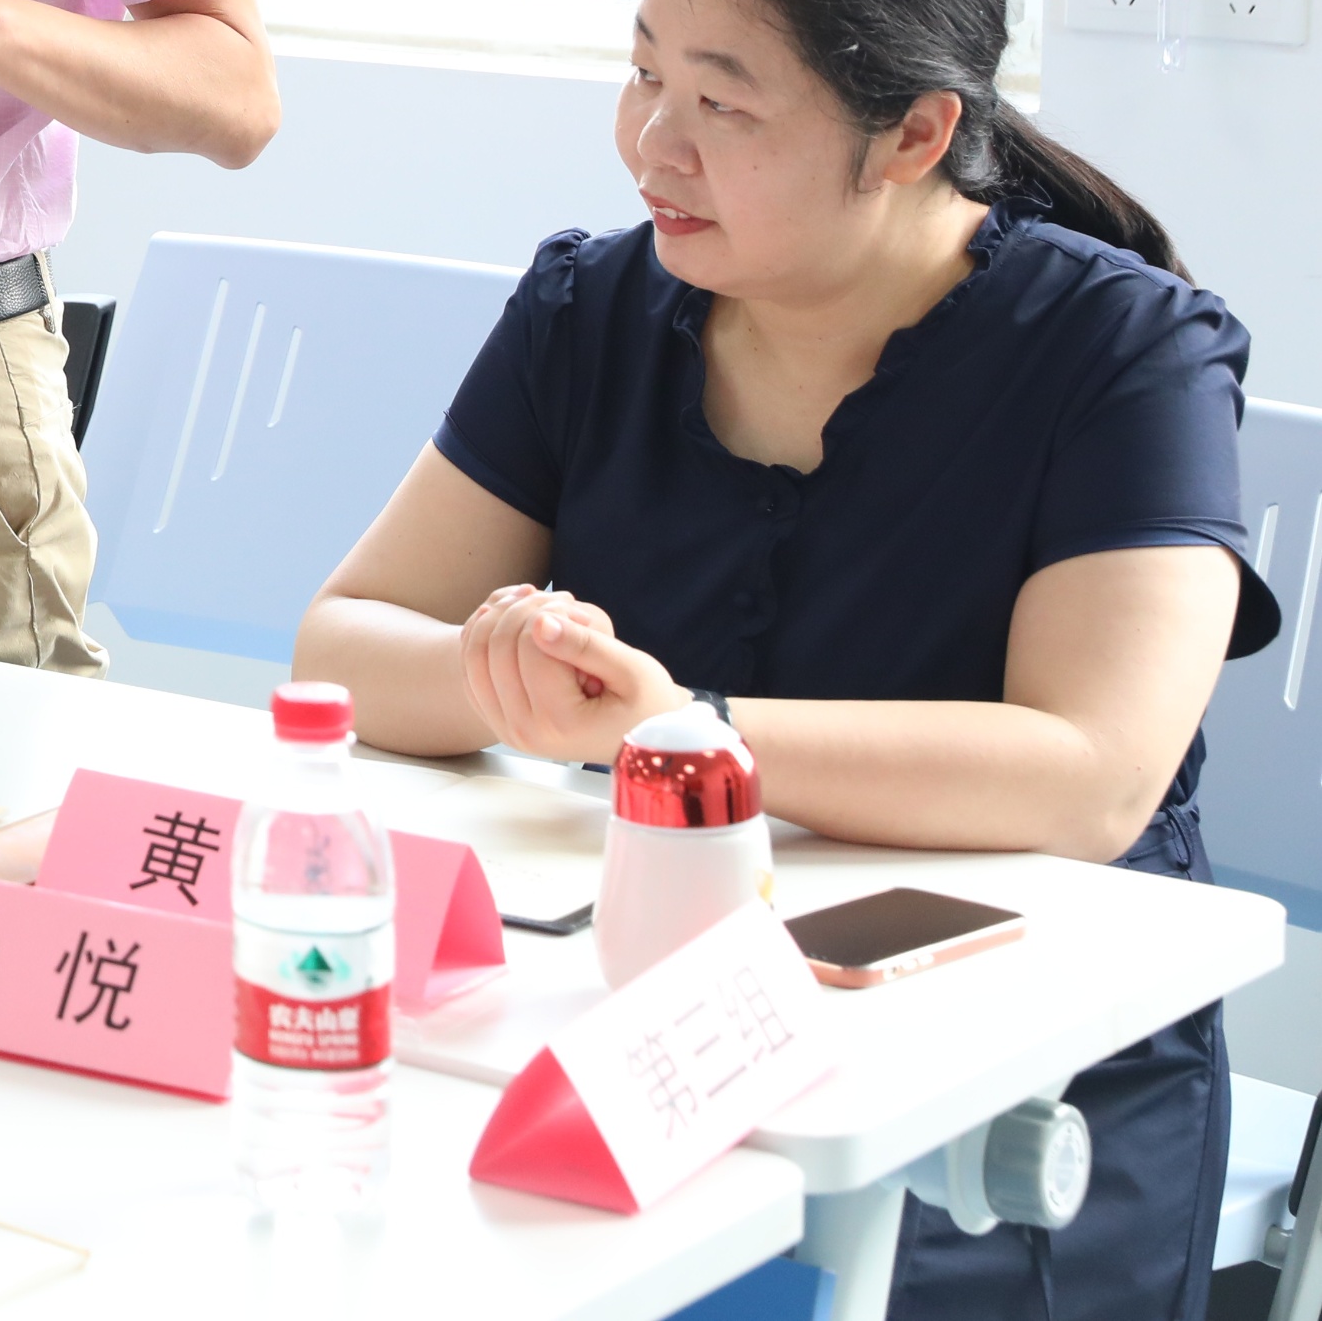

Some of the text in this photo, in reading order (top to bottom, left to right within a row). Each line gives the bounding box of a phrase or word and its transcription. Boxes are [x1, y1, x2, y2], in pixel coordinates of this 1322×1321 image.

[129, 810, 221, 907] 黄
[624, 965, 795, 1140] 第三组
